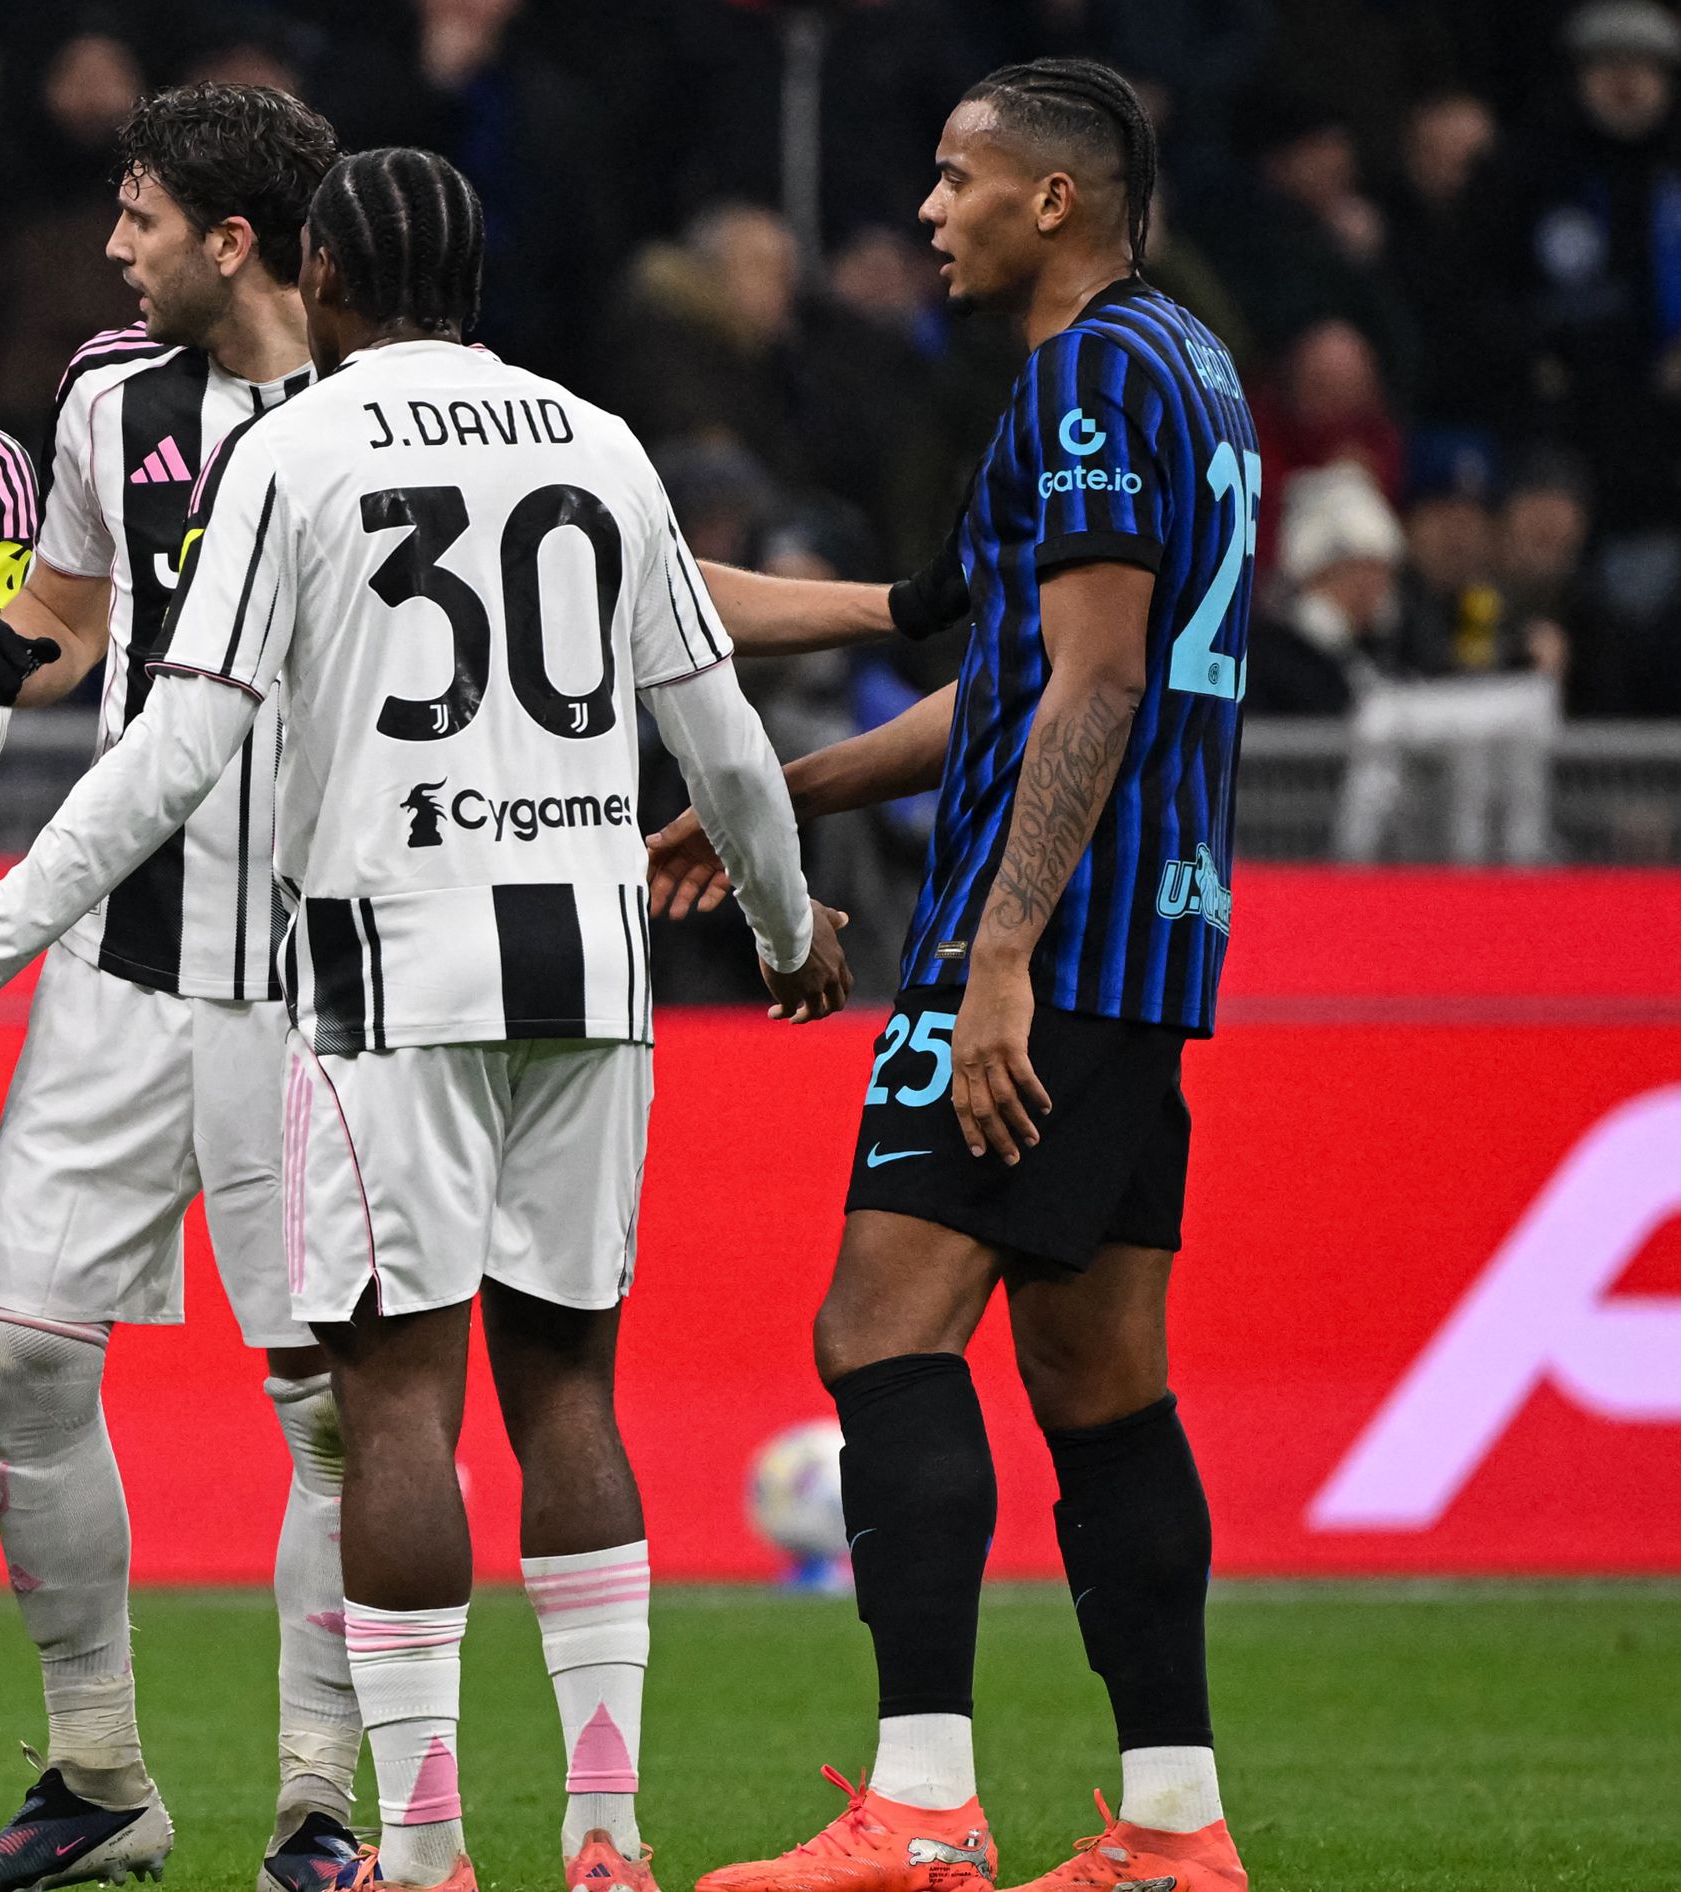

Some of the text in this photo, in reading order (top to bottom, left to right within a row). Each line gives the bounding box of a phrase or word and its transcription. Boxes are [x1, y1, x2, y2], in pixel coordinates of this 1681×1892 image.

[363, 399, 574, 449] J.DAVID
[360, 484, 623, 742] 30
[451, 788, 632, 842] Cygames
[864, 1010, 958, 1107] 25
